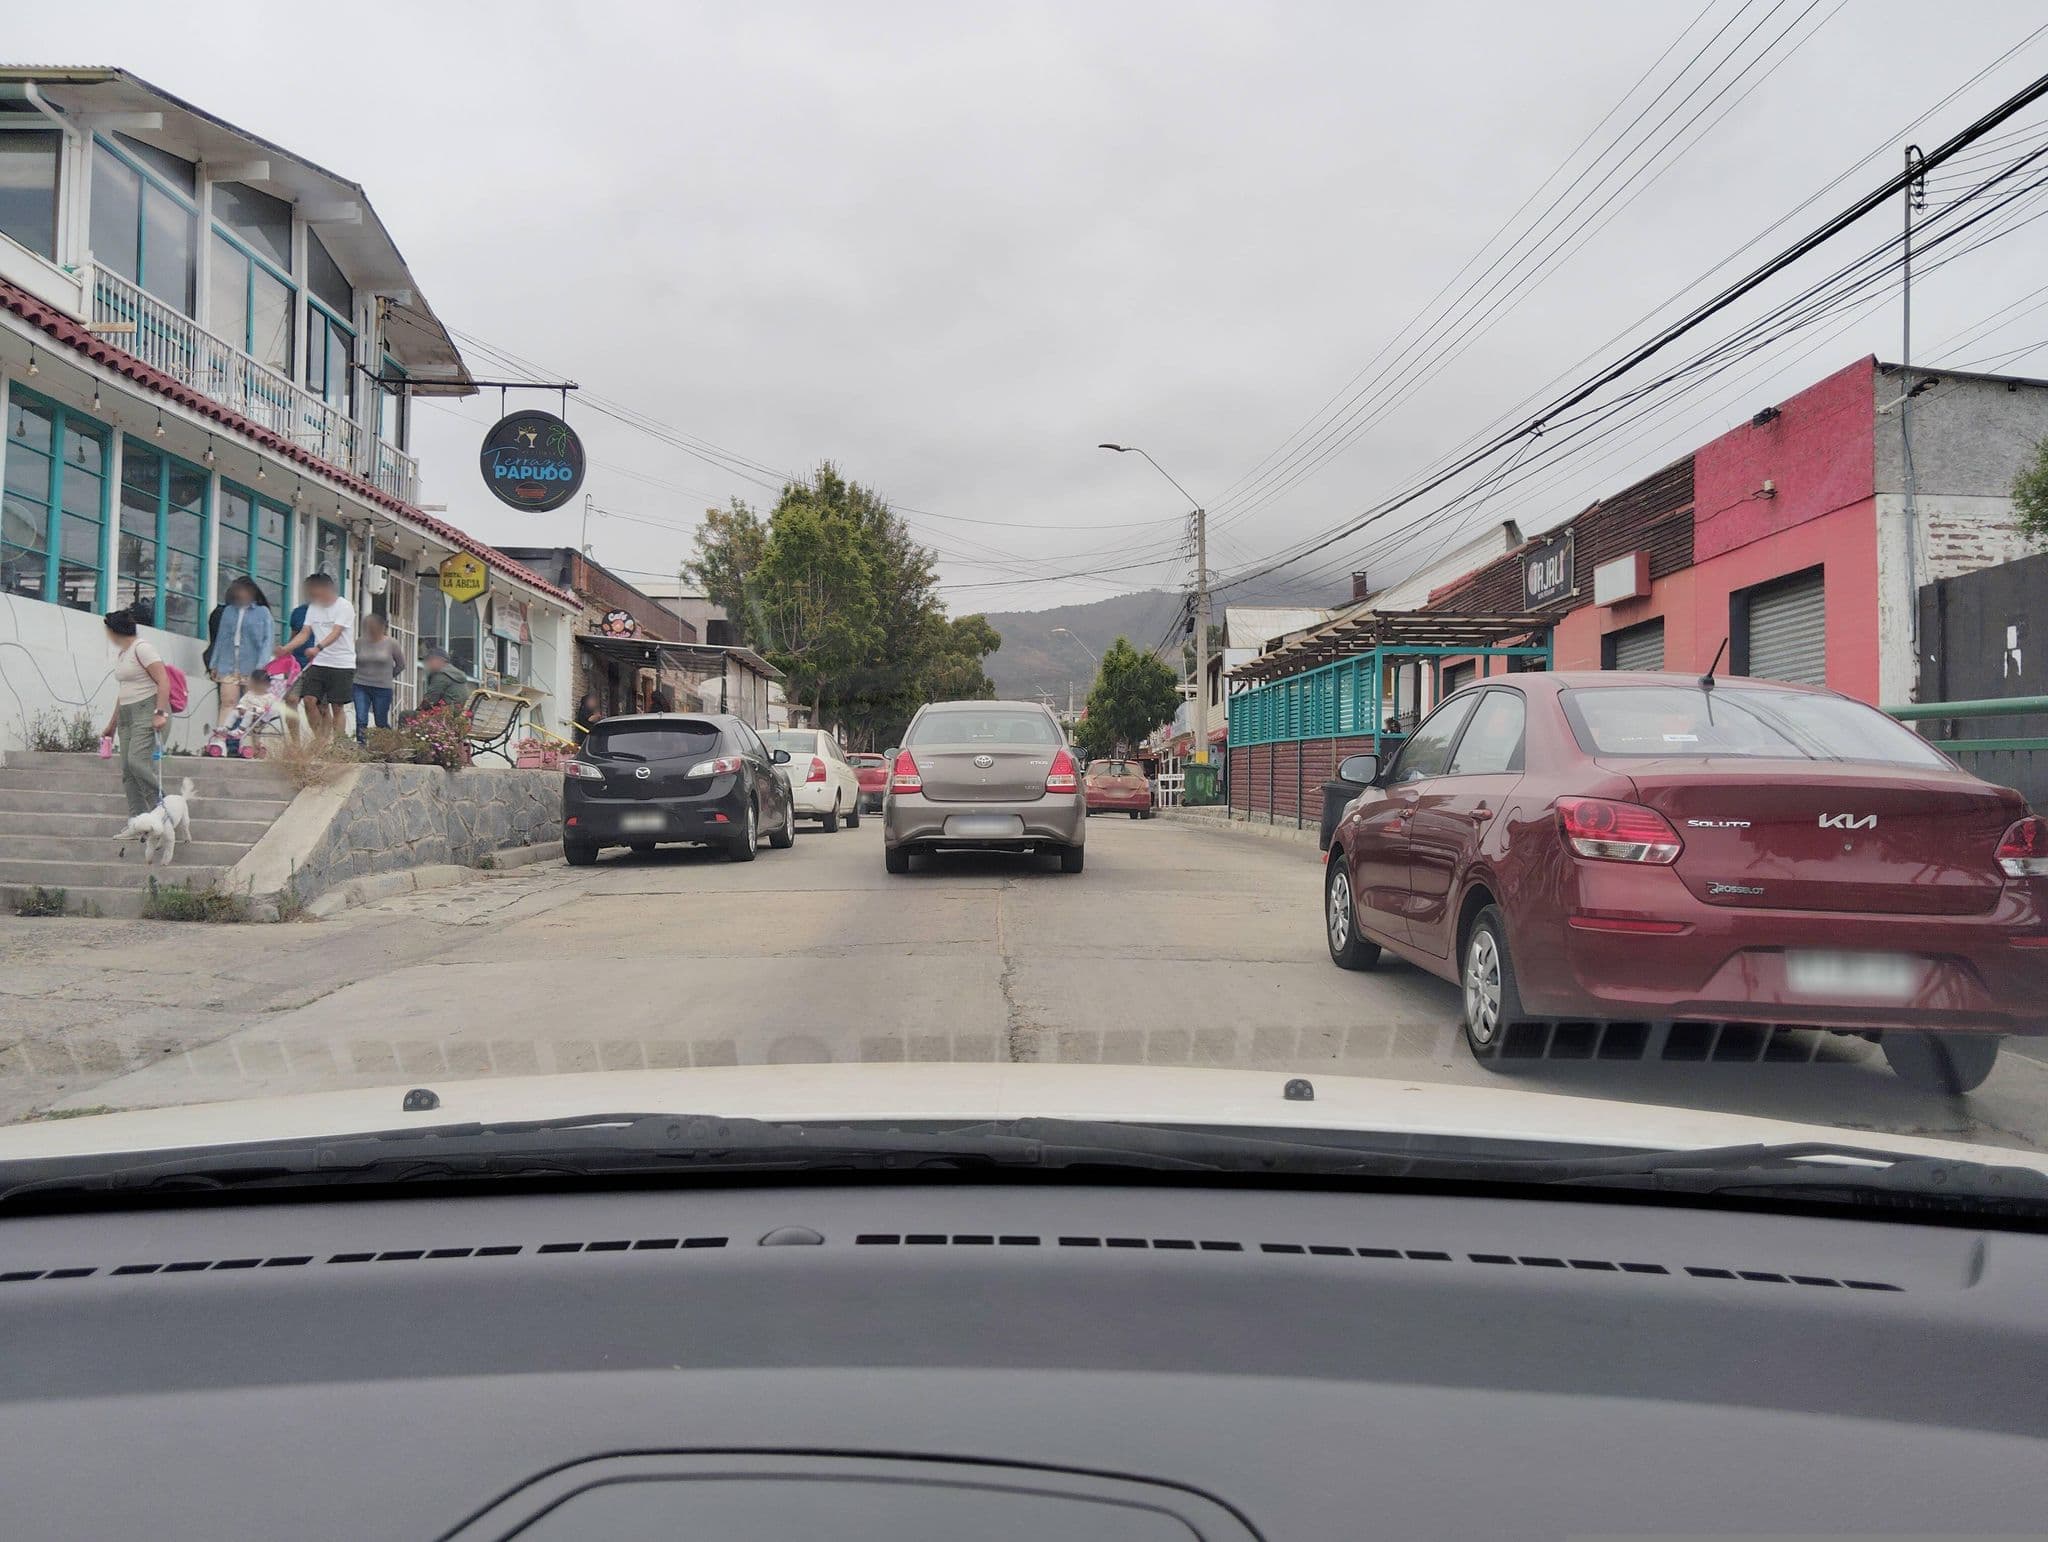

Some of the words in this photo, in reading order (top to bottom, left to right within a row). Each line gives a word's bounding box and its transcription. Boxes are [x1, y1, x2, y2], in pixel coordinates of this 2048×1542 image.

[495, 465, 573, 481] PAPUDO
[443, 579, 453, 588] LA
[1687, 820, 1751, 828] SOLUTO
[1818, 813, 1877, 830] KIA
